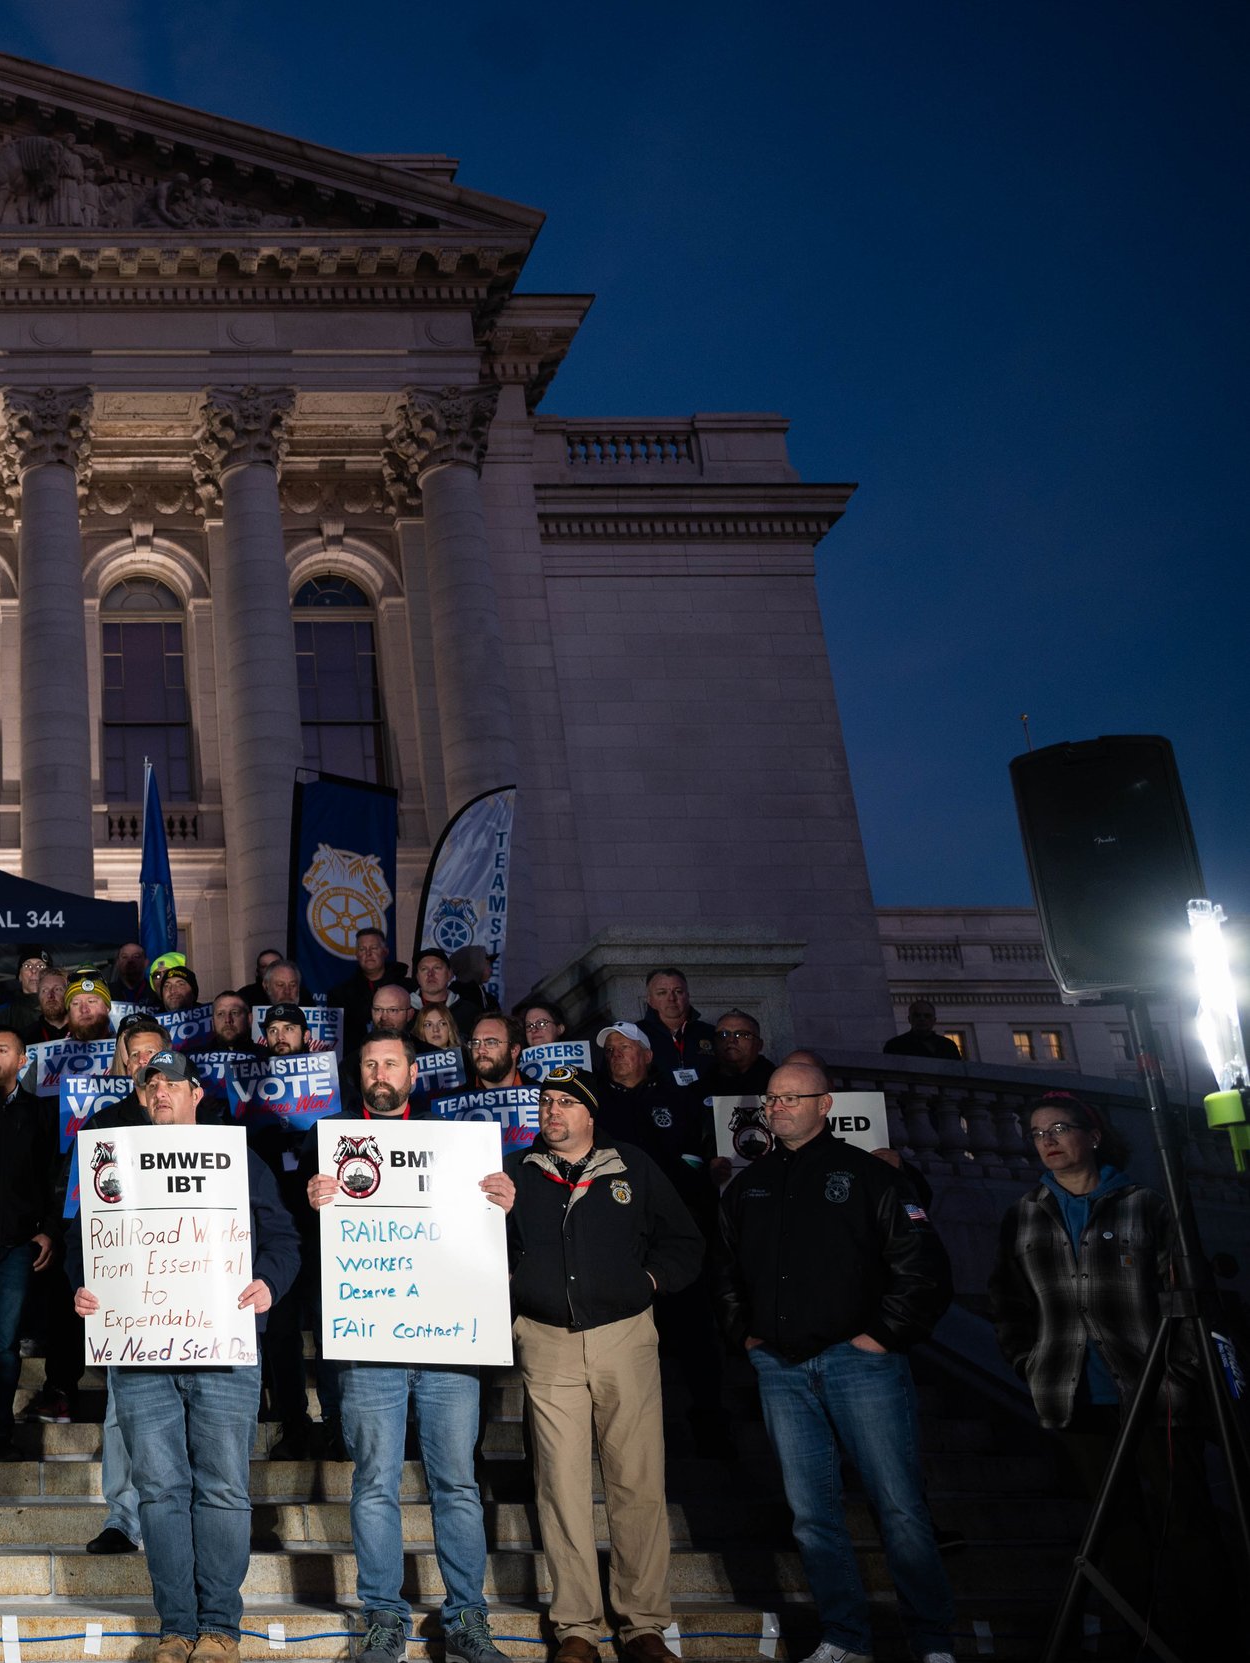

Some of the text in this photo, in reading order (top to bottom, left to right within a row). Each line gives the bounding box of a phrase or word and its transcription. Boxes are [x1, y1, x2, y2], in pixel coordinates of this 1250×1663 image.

[26, 910, 65, 928] 344
[156, 1006, 213, 1026] TEAMST
[230, 1055, 331, 1079] TEAMSTERS
[231, 1072, 332, 1102] VOTE
[294, 1089, 334, 1112] Win!
[438, 1088, 540, 1114] TEAMSTERS
[140, 1152, 231, 1170] BMWED
[390, 1150, 436, 1168] BM
[167, 1176, 206, 1193] IBT
[192, 1216, 251, 1244] Wrker
[93, 1250, 243, 1280] From Essental
[142, 1281, 168, 1306] to
[339, 1282, 420, 1301] Deserve A
[104, 1309, 214, 1335] Expendable
[88, 1336, 113, 1364] We
[119, 1336, 174, 1362] Need
[179, 1337, 221, 1362] Sick
